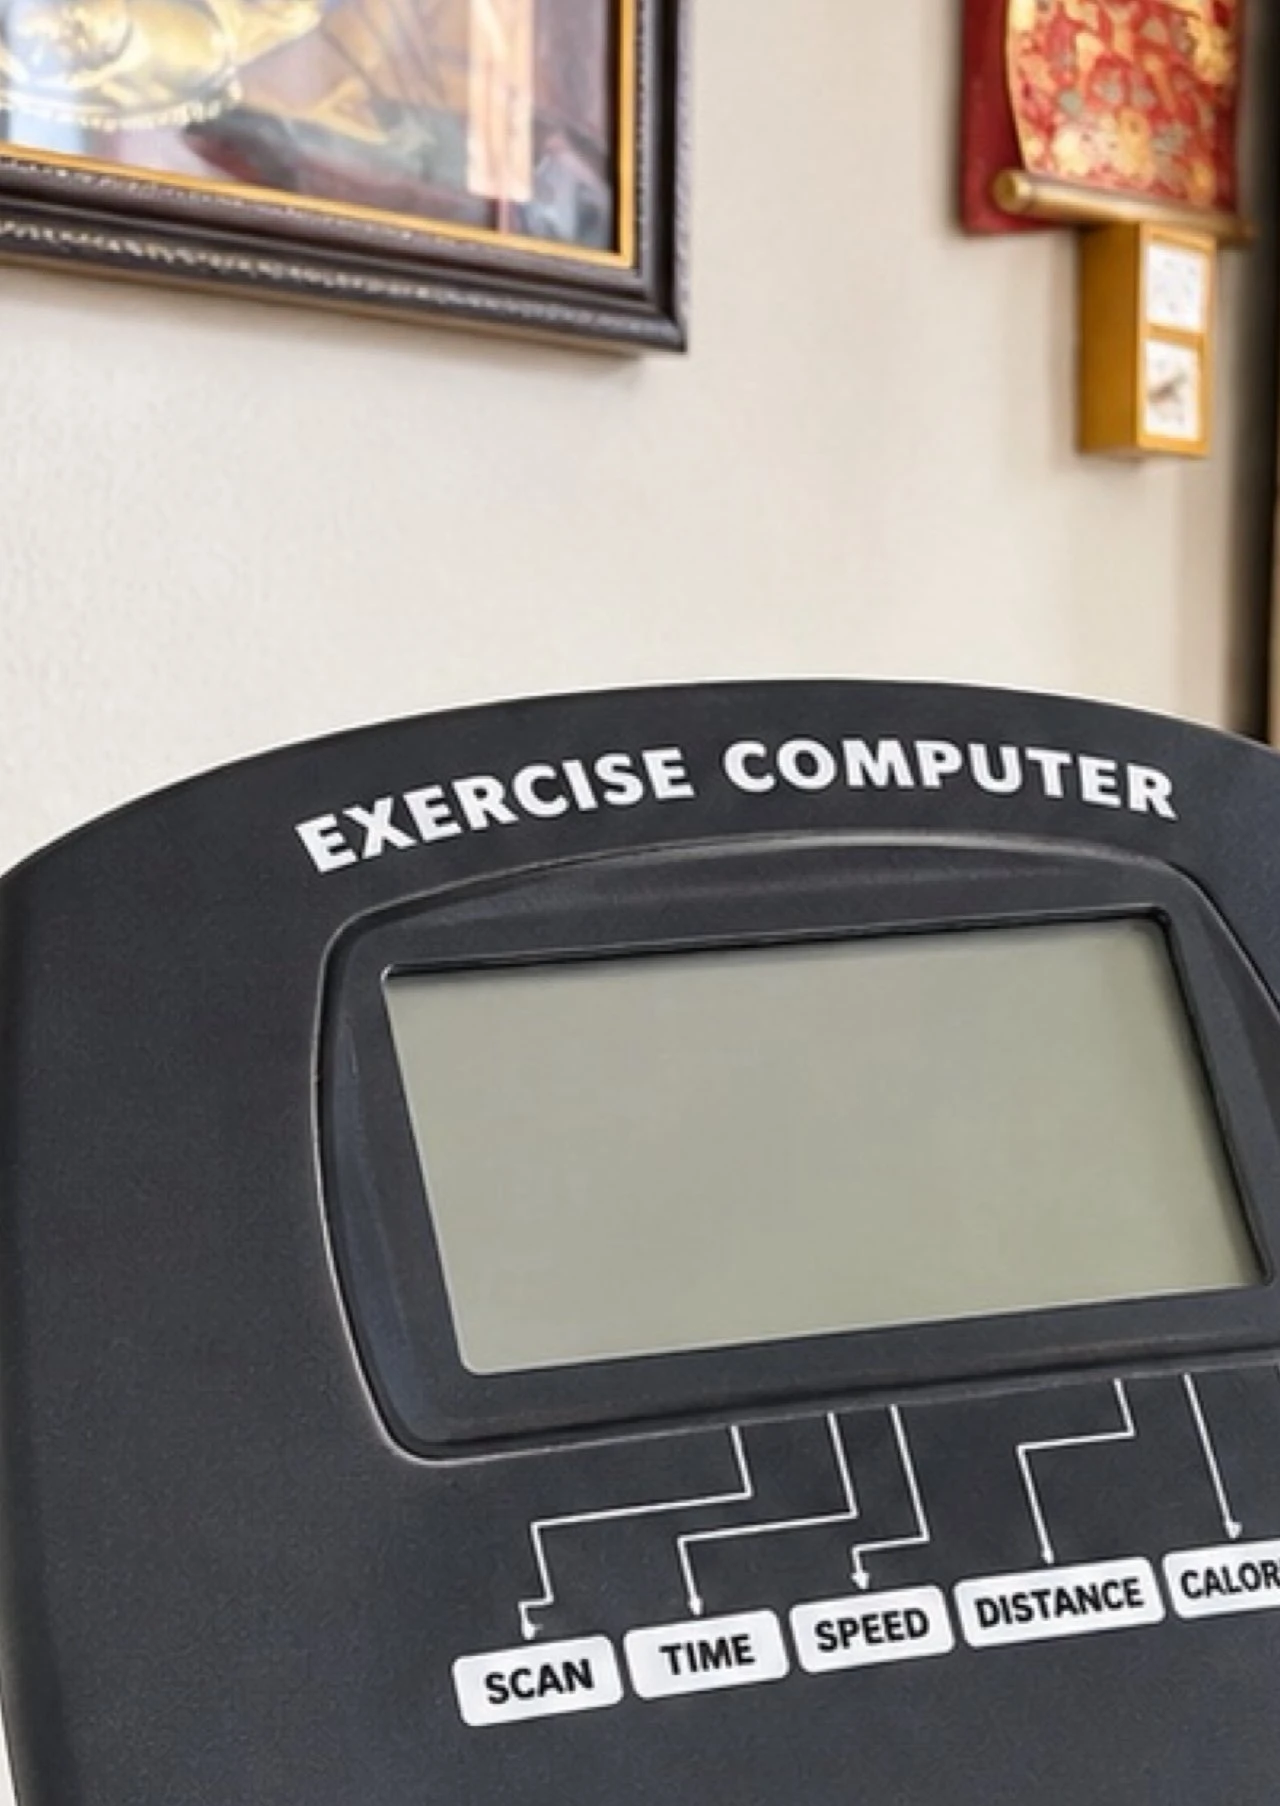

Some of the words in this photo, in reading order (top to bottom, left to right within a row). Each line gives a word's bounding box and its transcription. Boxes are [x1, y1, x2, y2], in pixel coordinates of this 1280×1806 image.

[295, 746, 695, 873] EXERCISE
[723, 739, 1177, 819] COMPUTER
[485, 1658, 594, 1705] SCAN
[659, 1633, 756, 1677] TIME
[814, 1607, 930, 1653] SPEED
[974, 1577, 1144, 1628] DISTANCE
